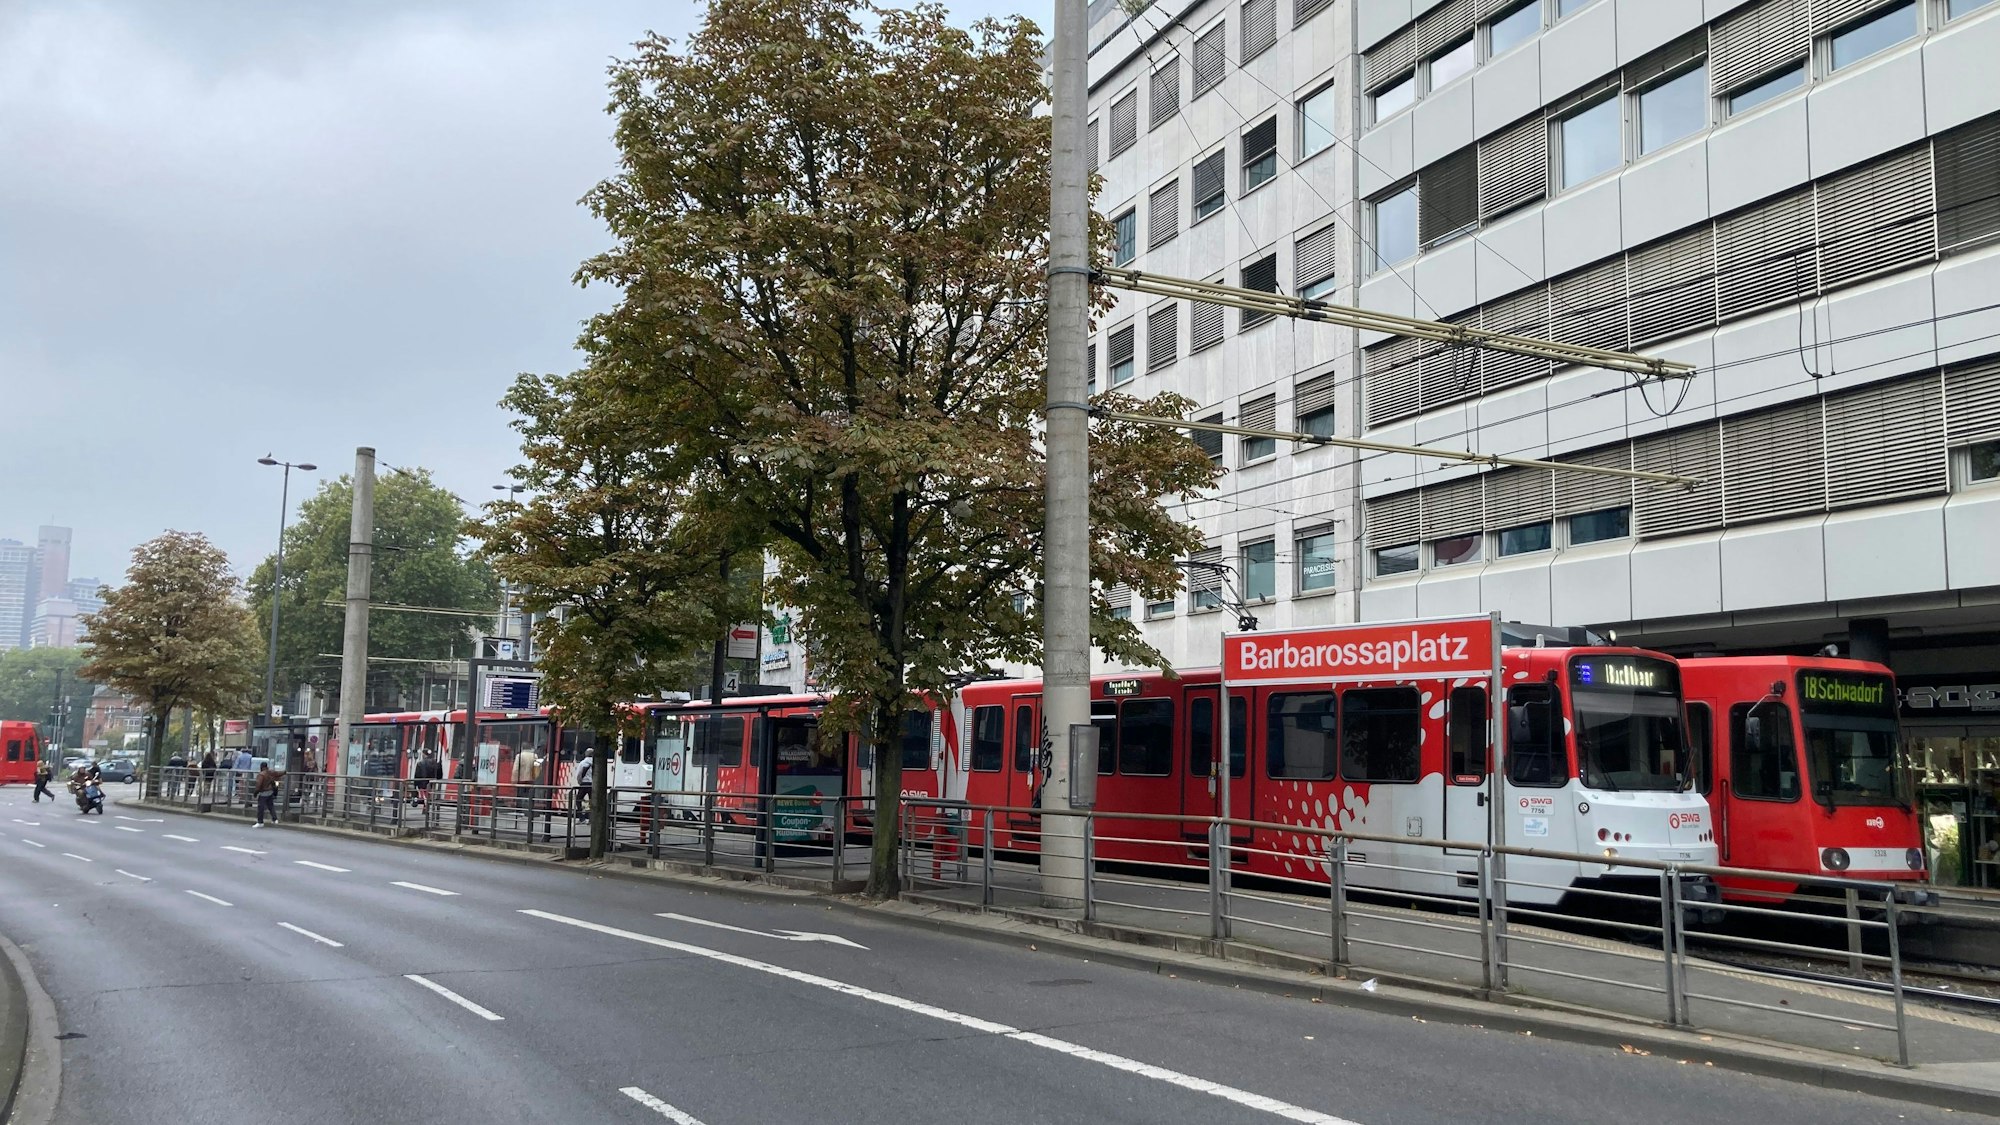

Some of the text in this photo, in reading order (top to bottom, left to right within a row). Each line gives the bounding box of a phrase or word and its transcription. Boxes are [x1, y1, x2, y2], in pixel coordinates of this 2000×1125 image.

[1240, 630, 1469, 671] Barbarossaplatz
[727, 678, 737, 691] 4
[1804, 676, 1817, 699] 18
[1818, 677, 1884, 703] Schwadorf
[658, 757, 671, 771] KVB
[1680, 813, 1700, 822] SWB
